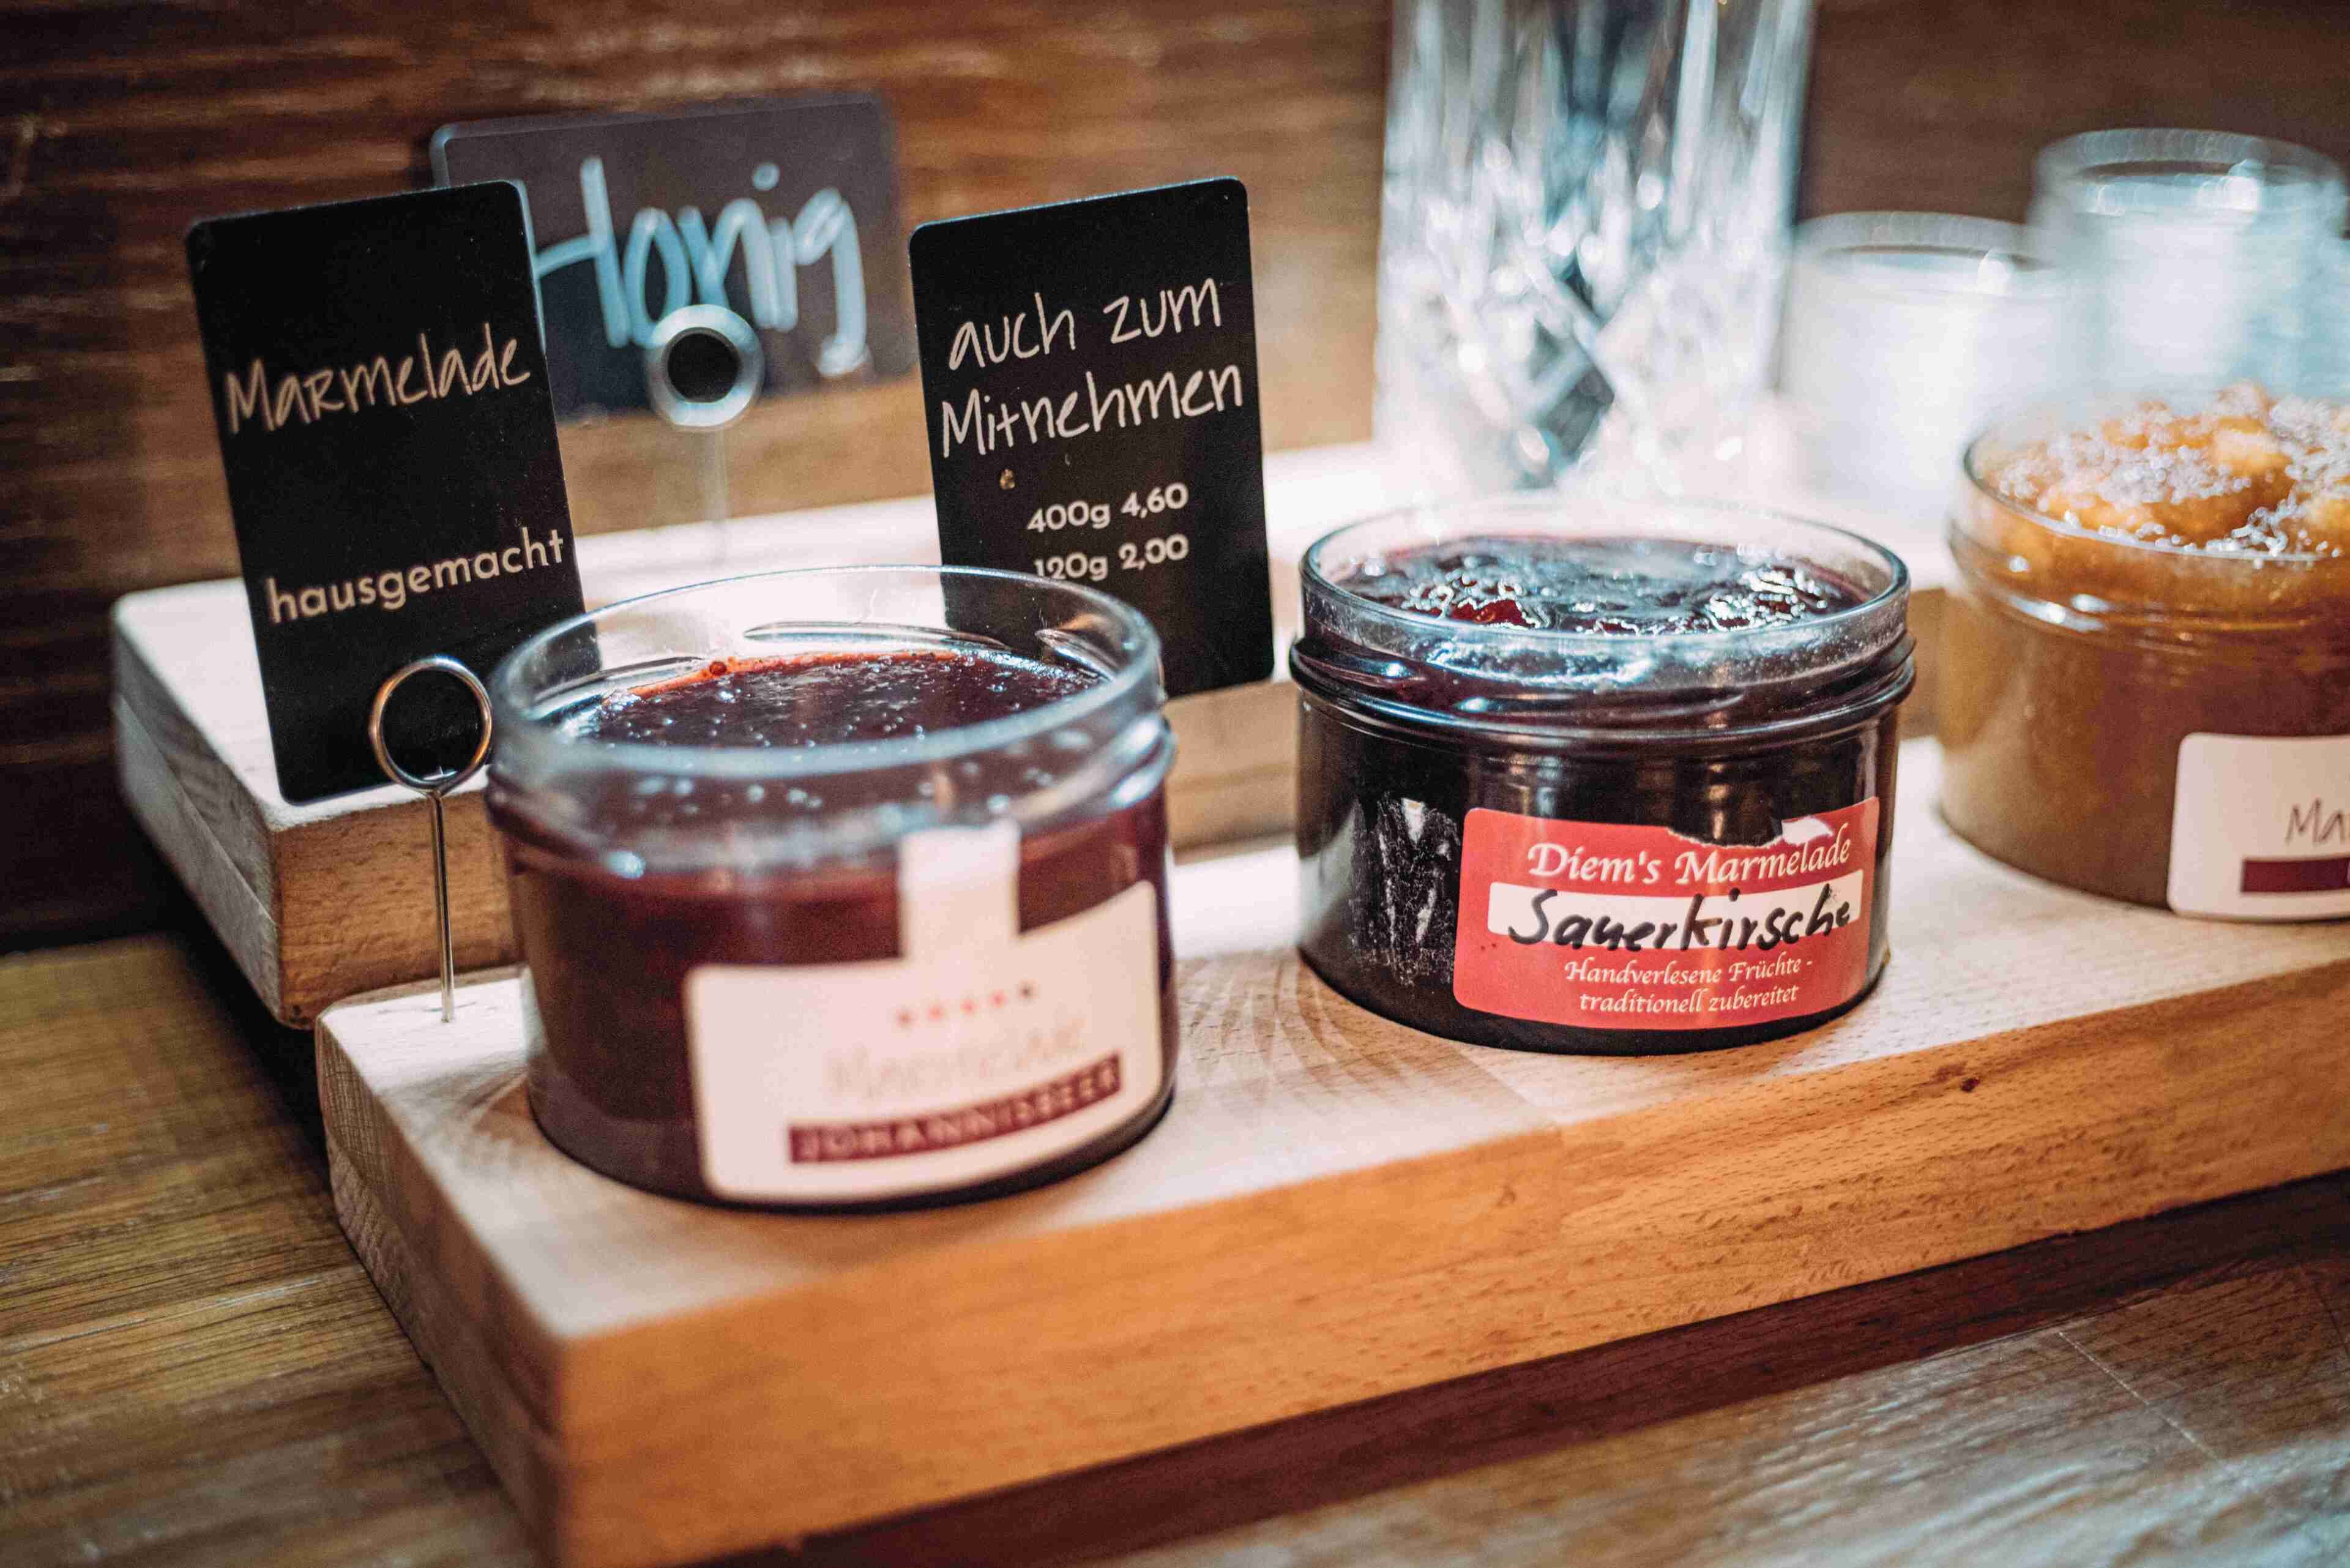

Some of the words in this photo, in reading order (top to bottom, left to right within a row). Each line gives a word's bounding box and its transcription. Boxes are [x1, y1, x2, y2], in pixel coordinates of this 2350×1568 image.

[949, 291, 1076, 371] auch
[1103, 277, 1222, 344] zum
[225, 322, 531, 434] Marmelade
[941, 365, 1243, 458] Mitnehmen
[1026, 499, 1111, 533] 400g
[1120, 482, 1189, 519] 4,60
[266, 525, 565, 625] hausgemacht
[1034, 551, 1108, 581] 120g
[1117, 533, 1189, 571] 2,00
[1528, 842, 1663, 885] Diem's
[1674, 822, 1851, 885] Marmelade
[1508, 883, 1851, 952] Sauerkirsche
[1564, 955, 1723, 985] Handverlesene
[1728, 950, 1802, 984] Früchte
[1578, 987, 1708, 1014] traditionell
[1707, 984, 1800, 1013] zubereitet
